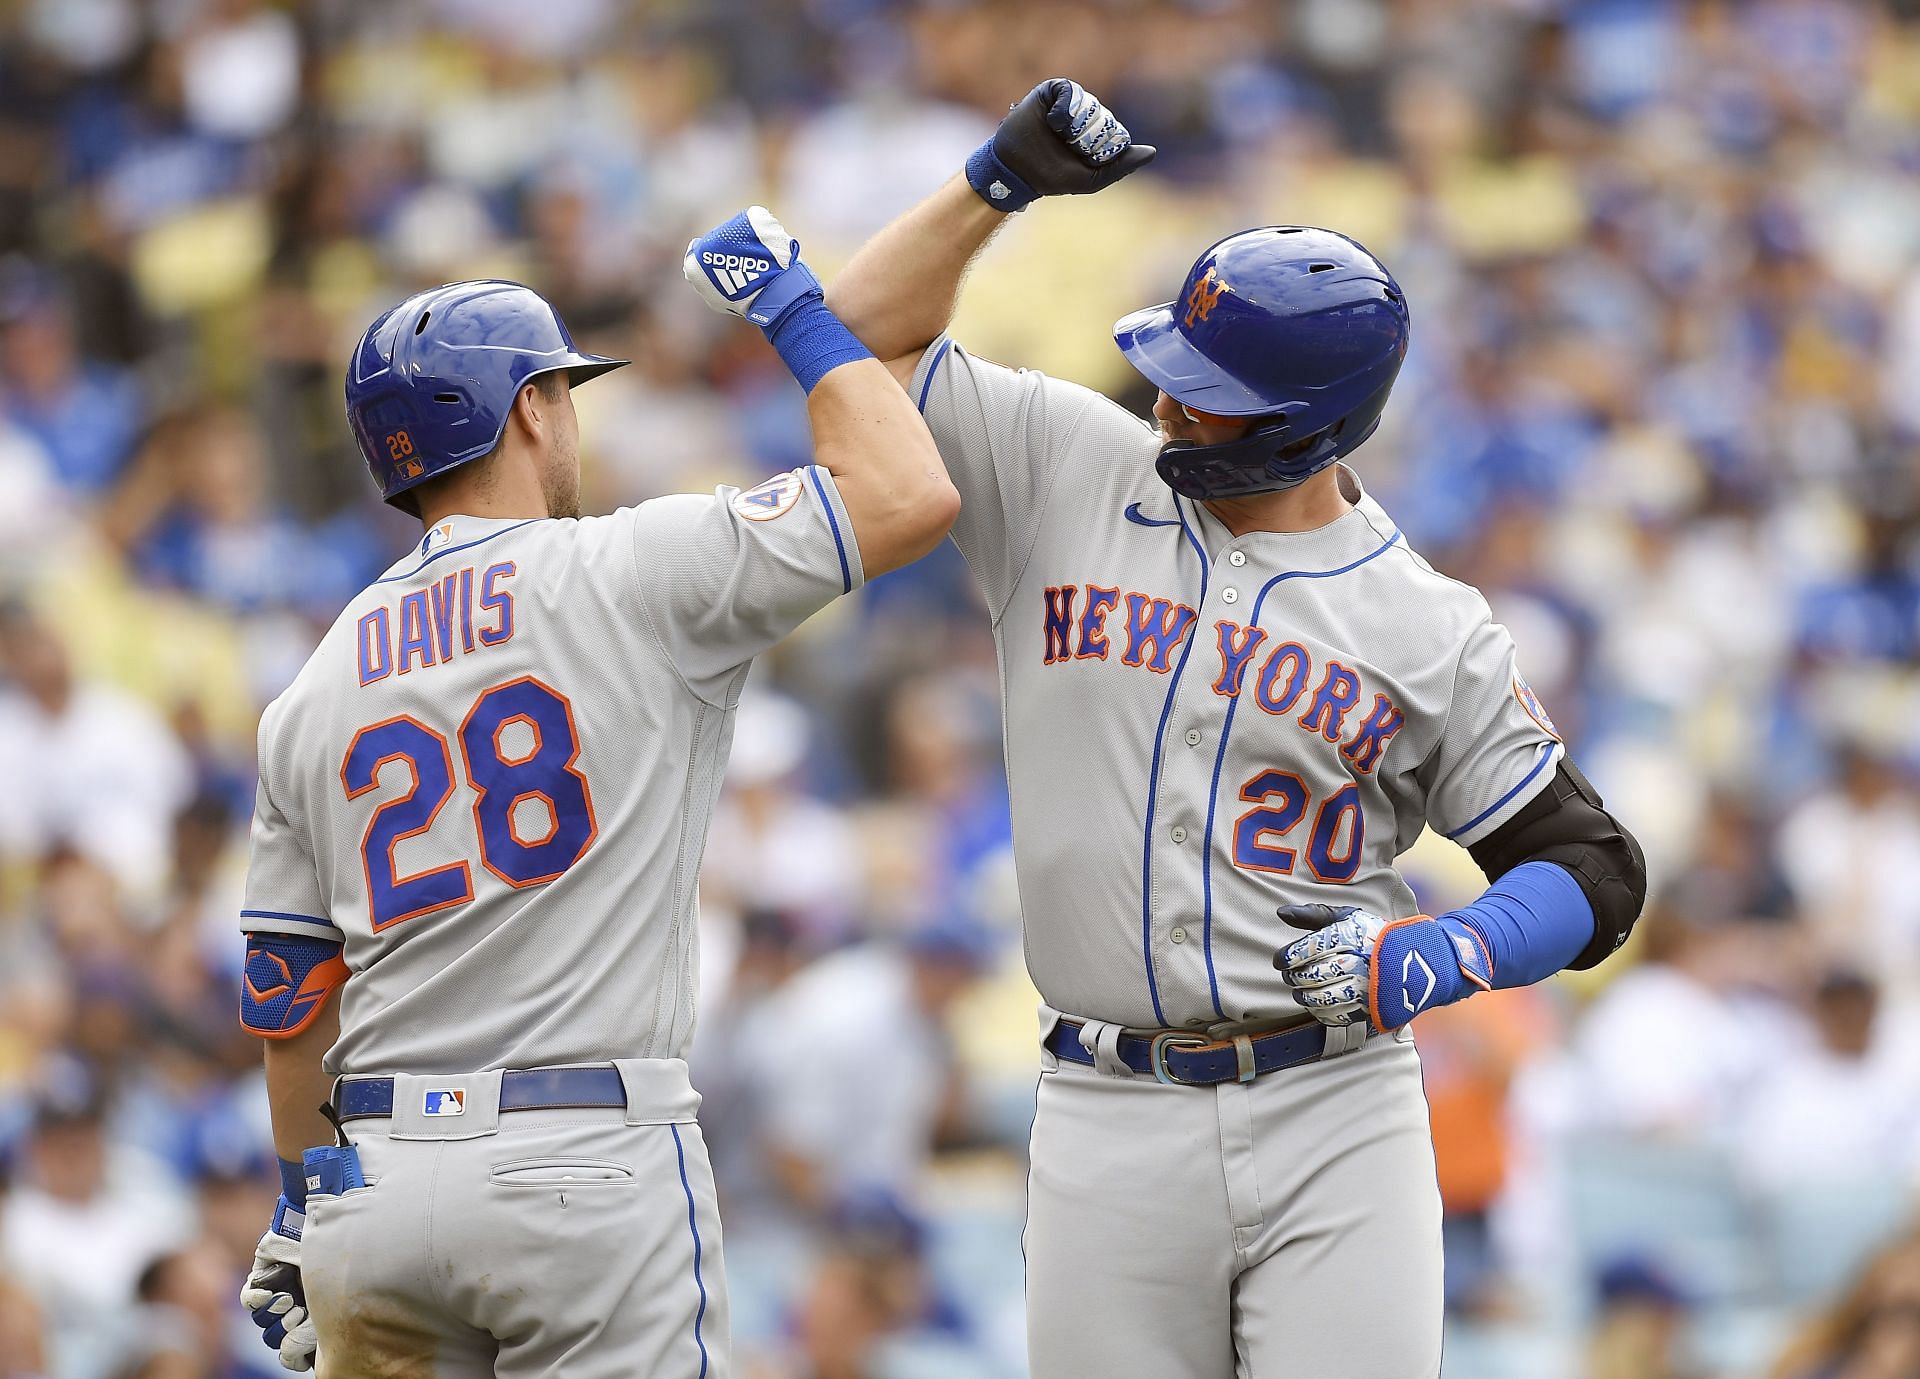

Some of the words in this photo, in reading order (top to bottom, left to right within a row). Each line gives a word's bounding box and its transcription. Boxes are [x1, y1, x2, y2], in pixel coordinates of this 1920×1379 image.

[702, 251, 770, 272] adidas
[386, 430, 413, 460] 28
[357, 560, 517, 687] DAVIS
[1043, 583, 1197, 673] NEW
[1212, 619, 1405, 775] YORK
[339, 674, 599, 934] 28
[1232, 768, 1365, 884] 20
